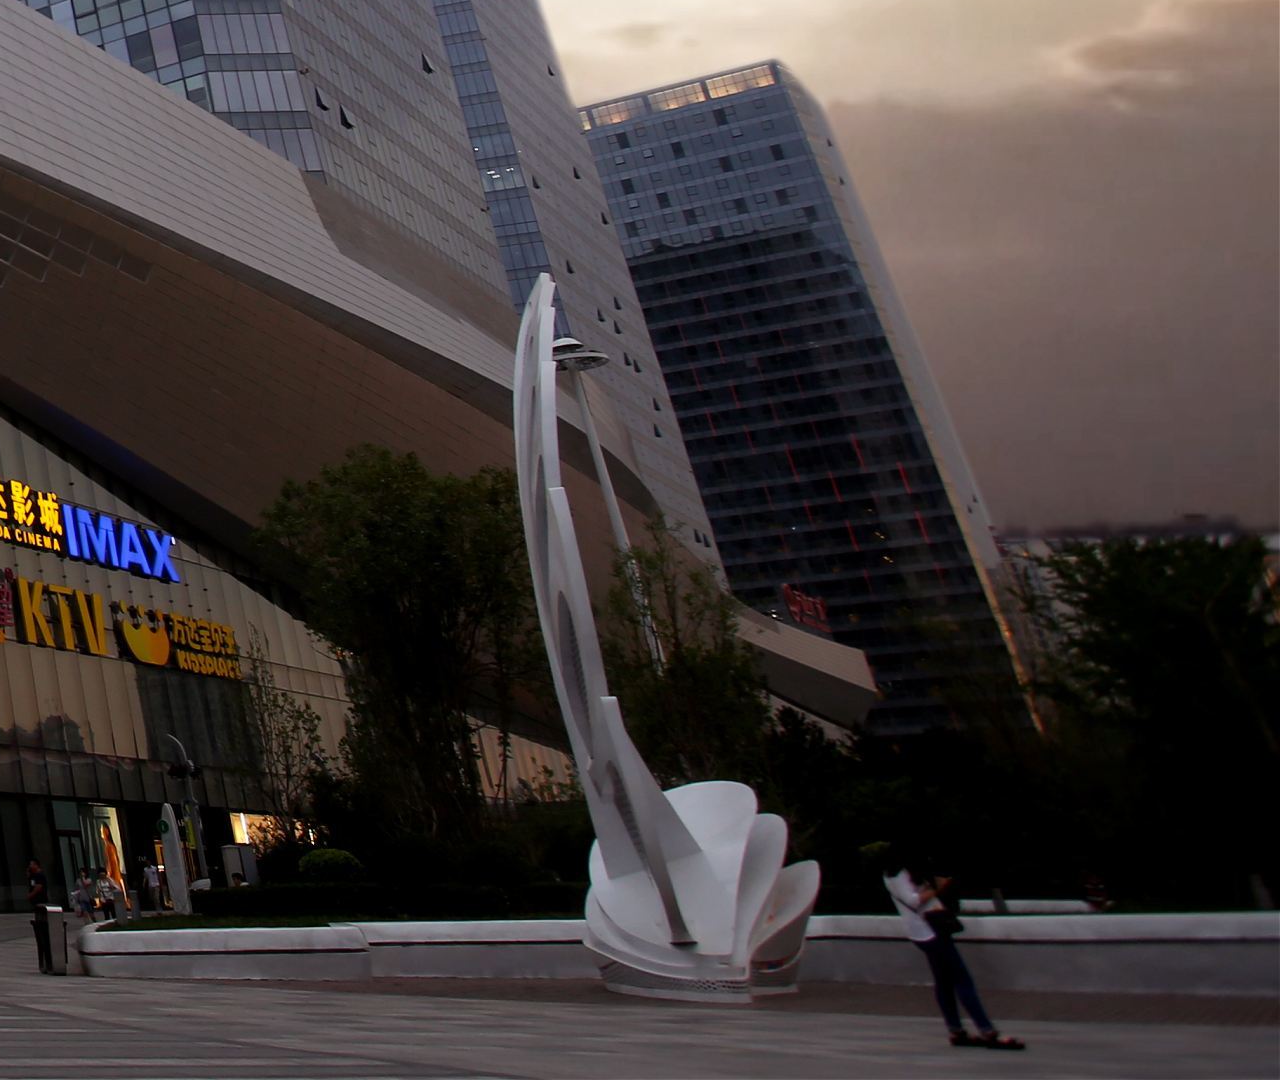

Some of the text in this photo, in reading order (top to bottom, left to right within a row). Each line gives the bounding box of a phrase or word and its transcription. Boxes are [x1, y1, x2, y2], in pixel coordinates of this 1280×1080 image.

[15, 529, 61, 552] CINEMA
[62, 503, 180, 583] IMAX
[17, 577, 108, 656] KTV
